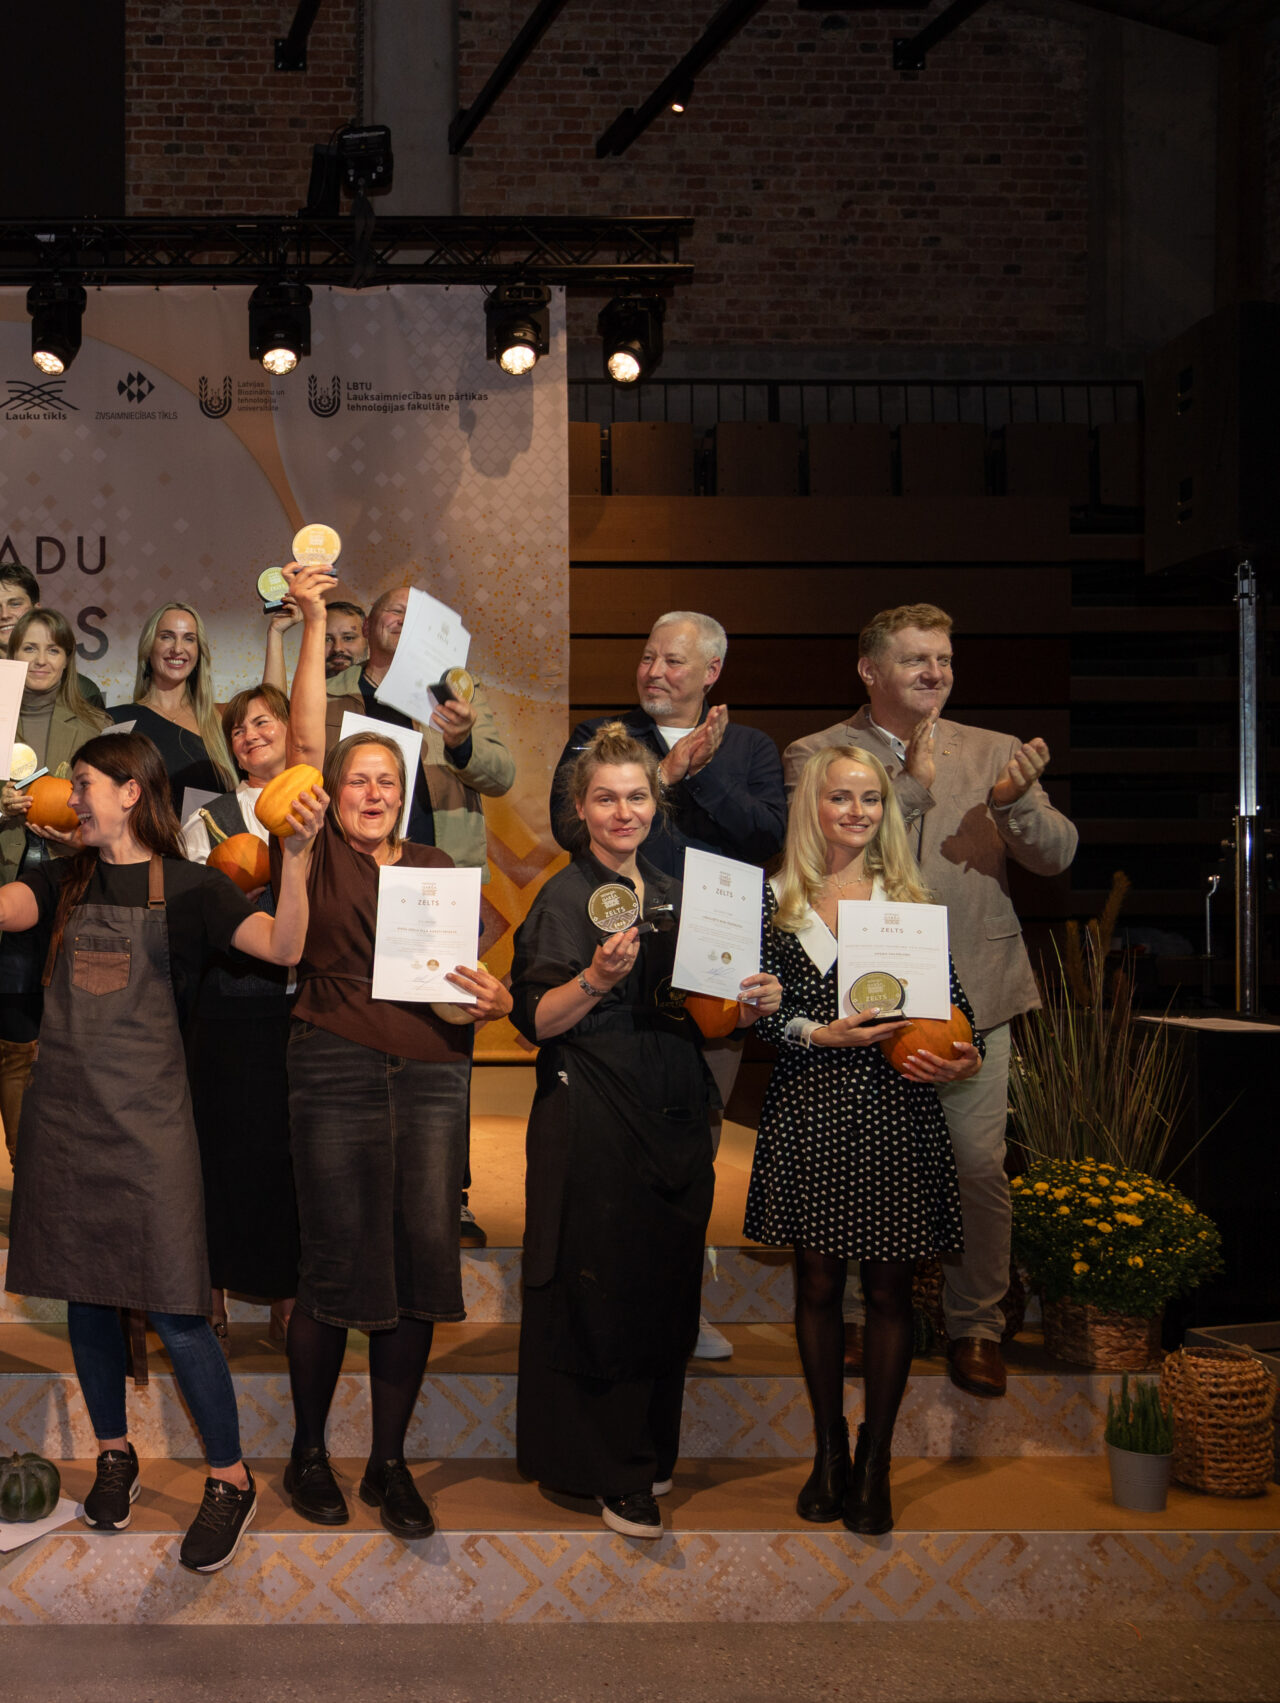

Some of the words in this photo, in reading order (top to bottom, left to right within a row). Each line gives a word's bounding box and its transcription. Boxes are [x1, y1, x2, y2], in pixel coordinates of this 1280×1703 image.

[346, 381, 373, 391] LBTU
[346, 391, 433, 401] Lauksaimniecības
[434, 393, 447, 401] un
[448, 391, 489, 403] pārtikas
[407, 402, 450, 412] fakultāte
[6, 411, 41, 421] Lauku
[42, 411, 68, 421] tīkls
[715, 887, 734, 898] ZELTS
[417, 899, 440, 907] ZELTS
[604, 906, 626, 918] ZELTS
